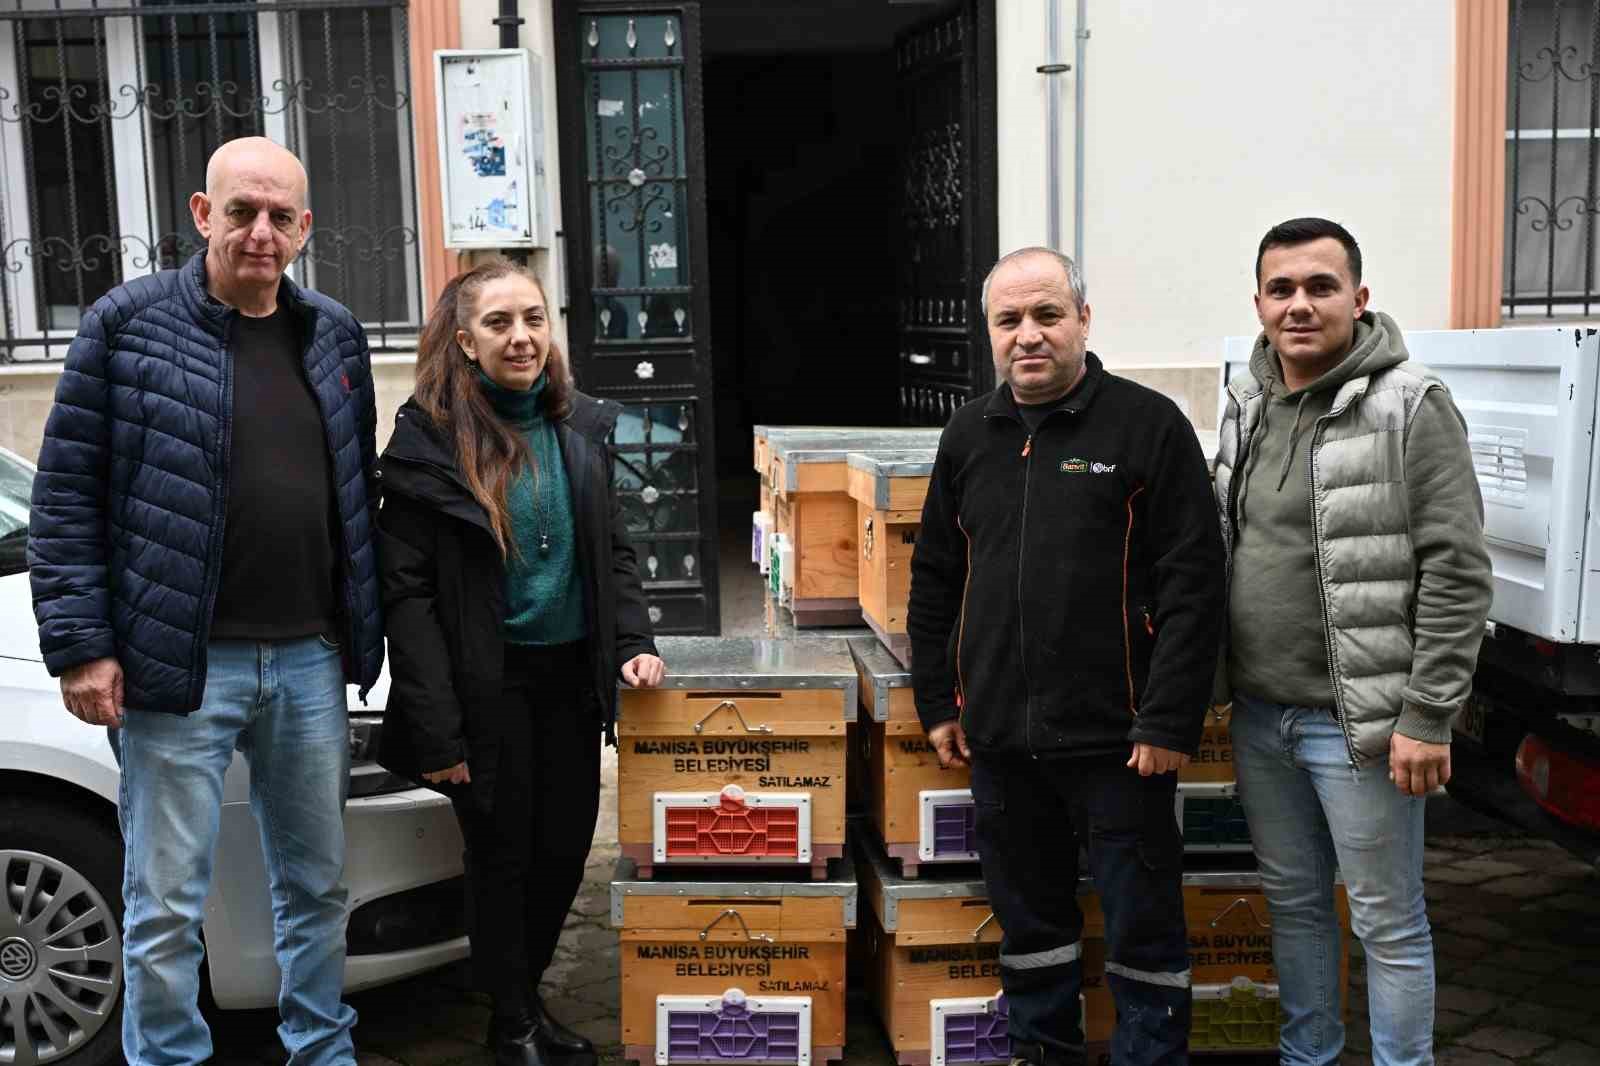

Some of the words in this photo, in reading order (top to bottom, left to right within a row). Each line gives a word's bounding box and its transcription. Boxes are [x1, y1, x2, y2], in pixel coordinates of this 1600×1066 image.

[674, 755, 770, 772] BELEDİYESİ
[759, 776, 831, 788] SATILAMAZ
[676, 960, 770, 976] BELEDİYESİ
